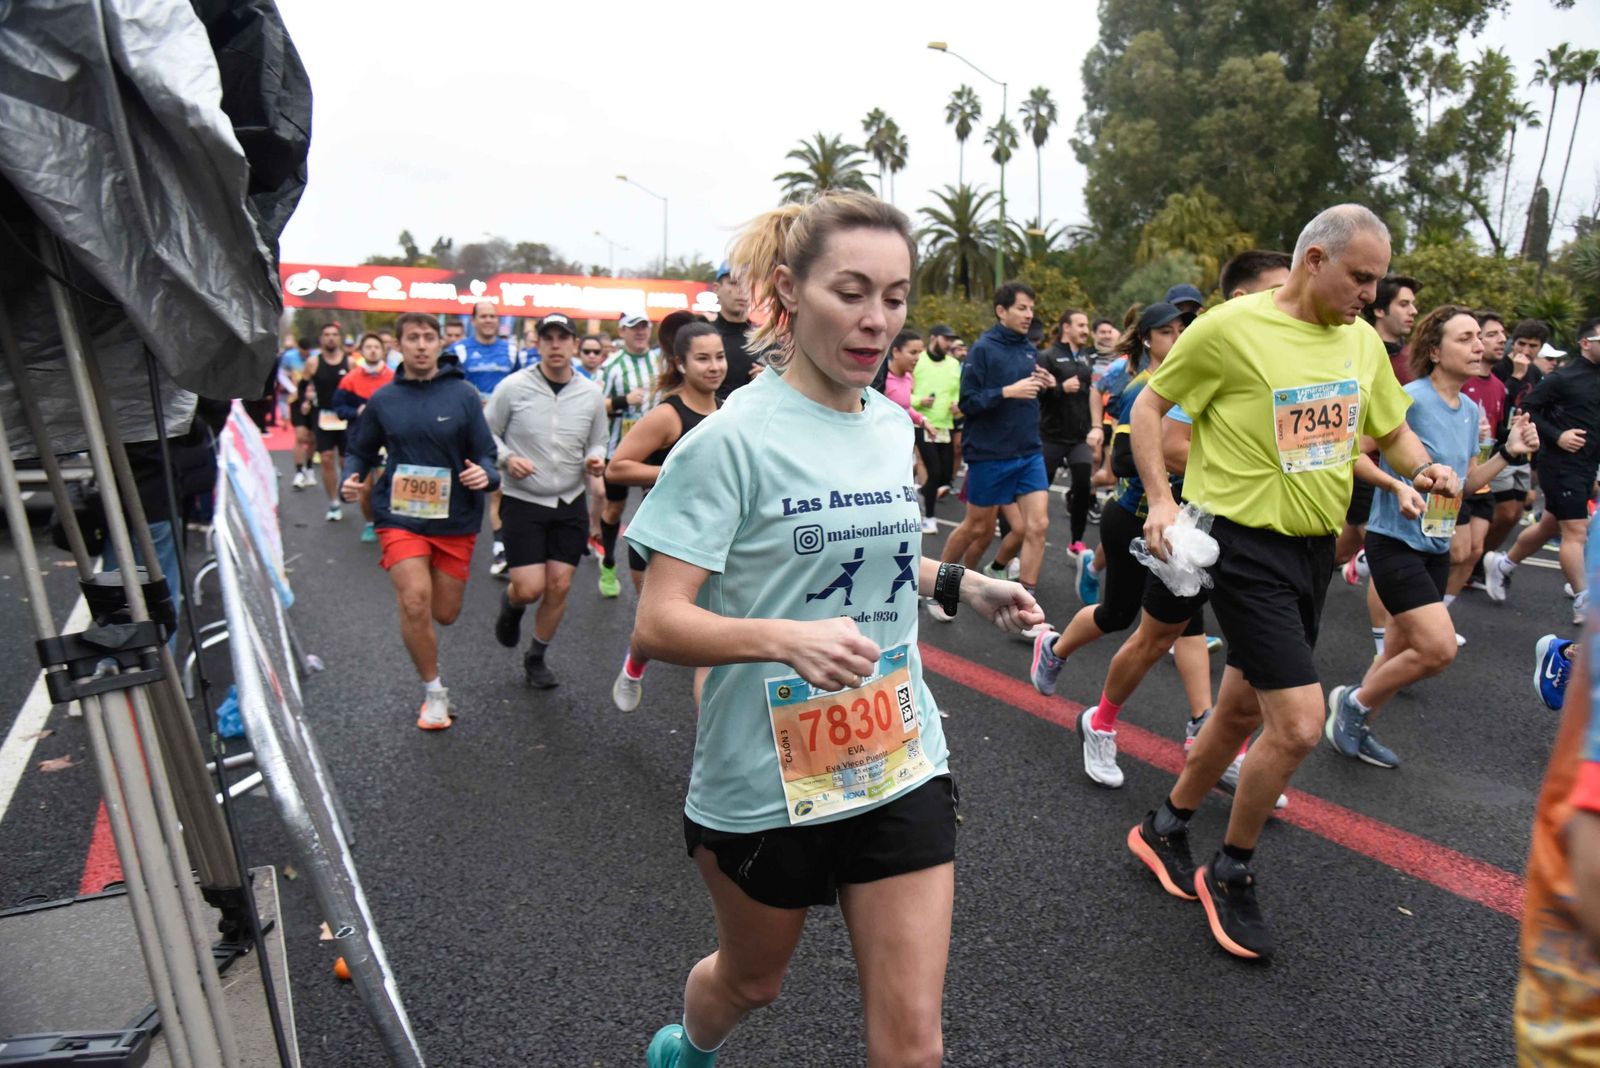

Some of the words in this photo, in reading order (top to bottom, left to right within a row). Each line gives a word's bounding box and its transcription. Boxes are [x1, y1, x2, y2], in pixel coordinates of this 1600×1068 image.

[1290, 403, 1343, 434] 7343
[402, 477, 437, 495] 7908
[782, 497, 823, 516] Las
[829, 490, 893, 508] Arenas
[872, 611, 898, 622] 1930
[799, 690, 892, 752] 7830
[782, 736, 793, 763] CAJÓN
[848, 744, 865, 755] EVA
[826, 763, 840, 773] Eva
[843, 790, 866, 801] HOKA
